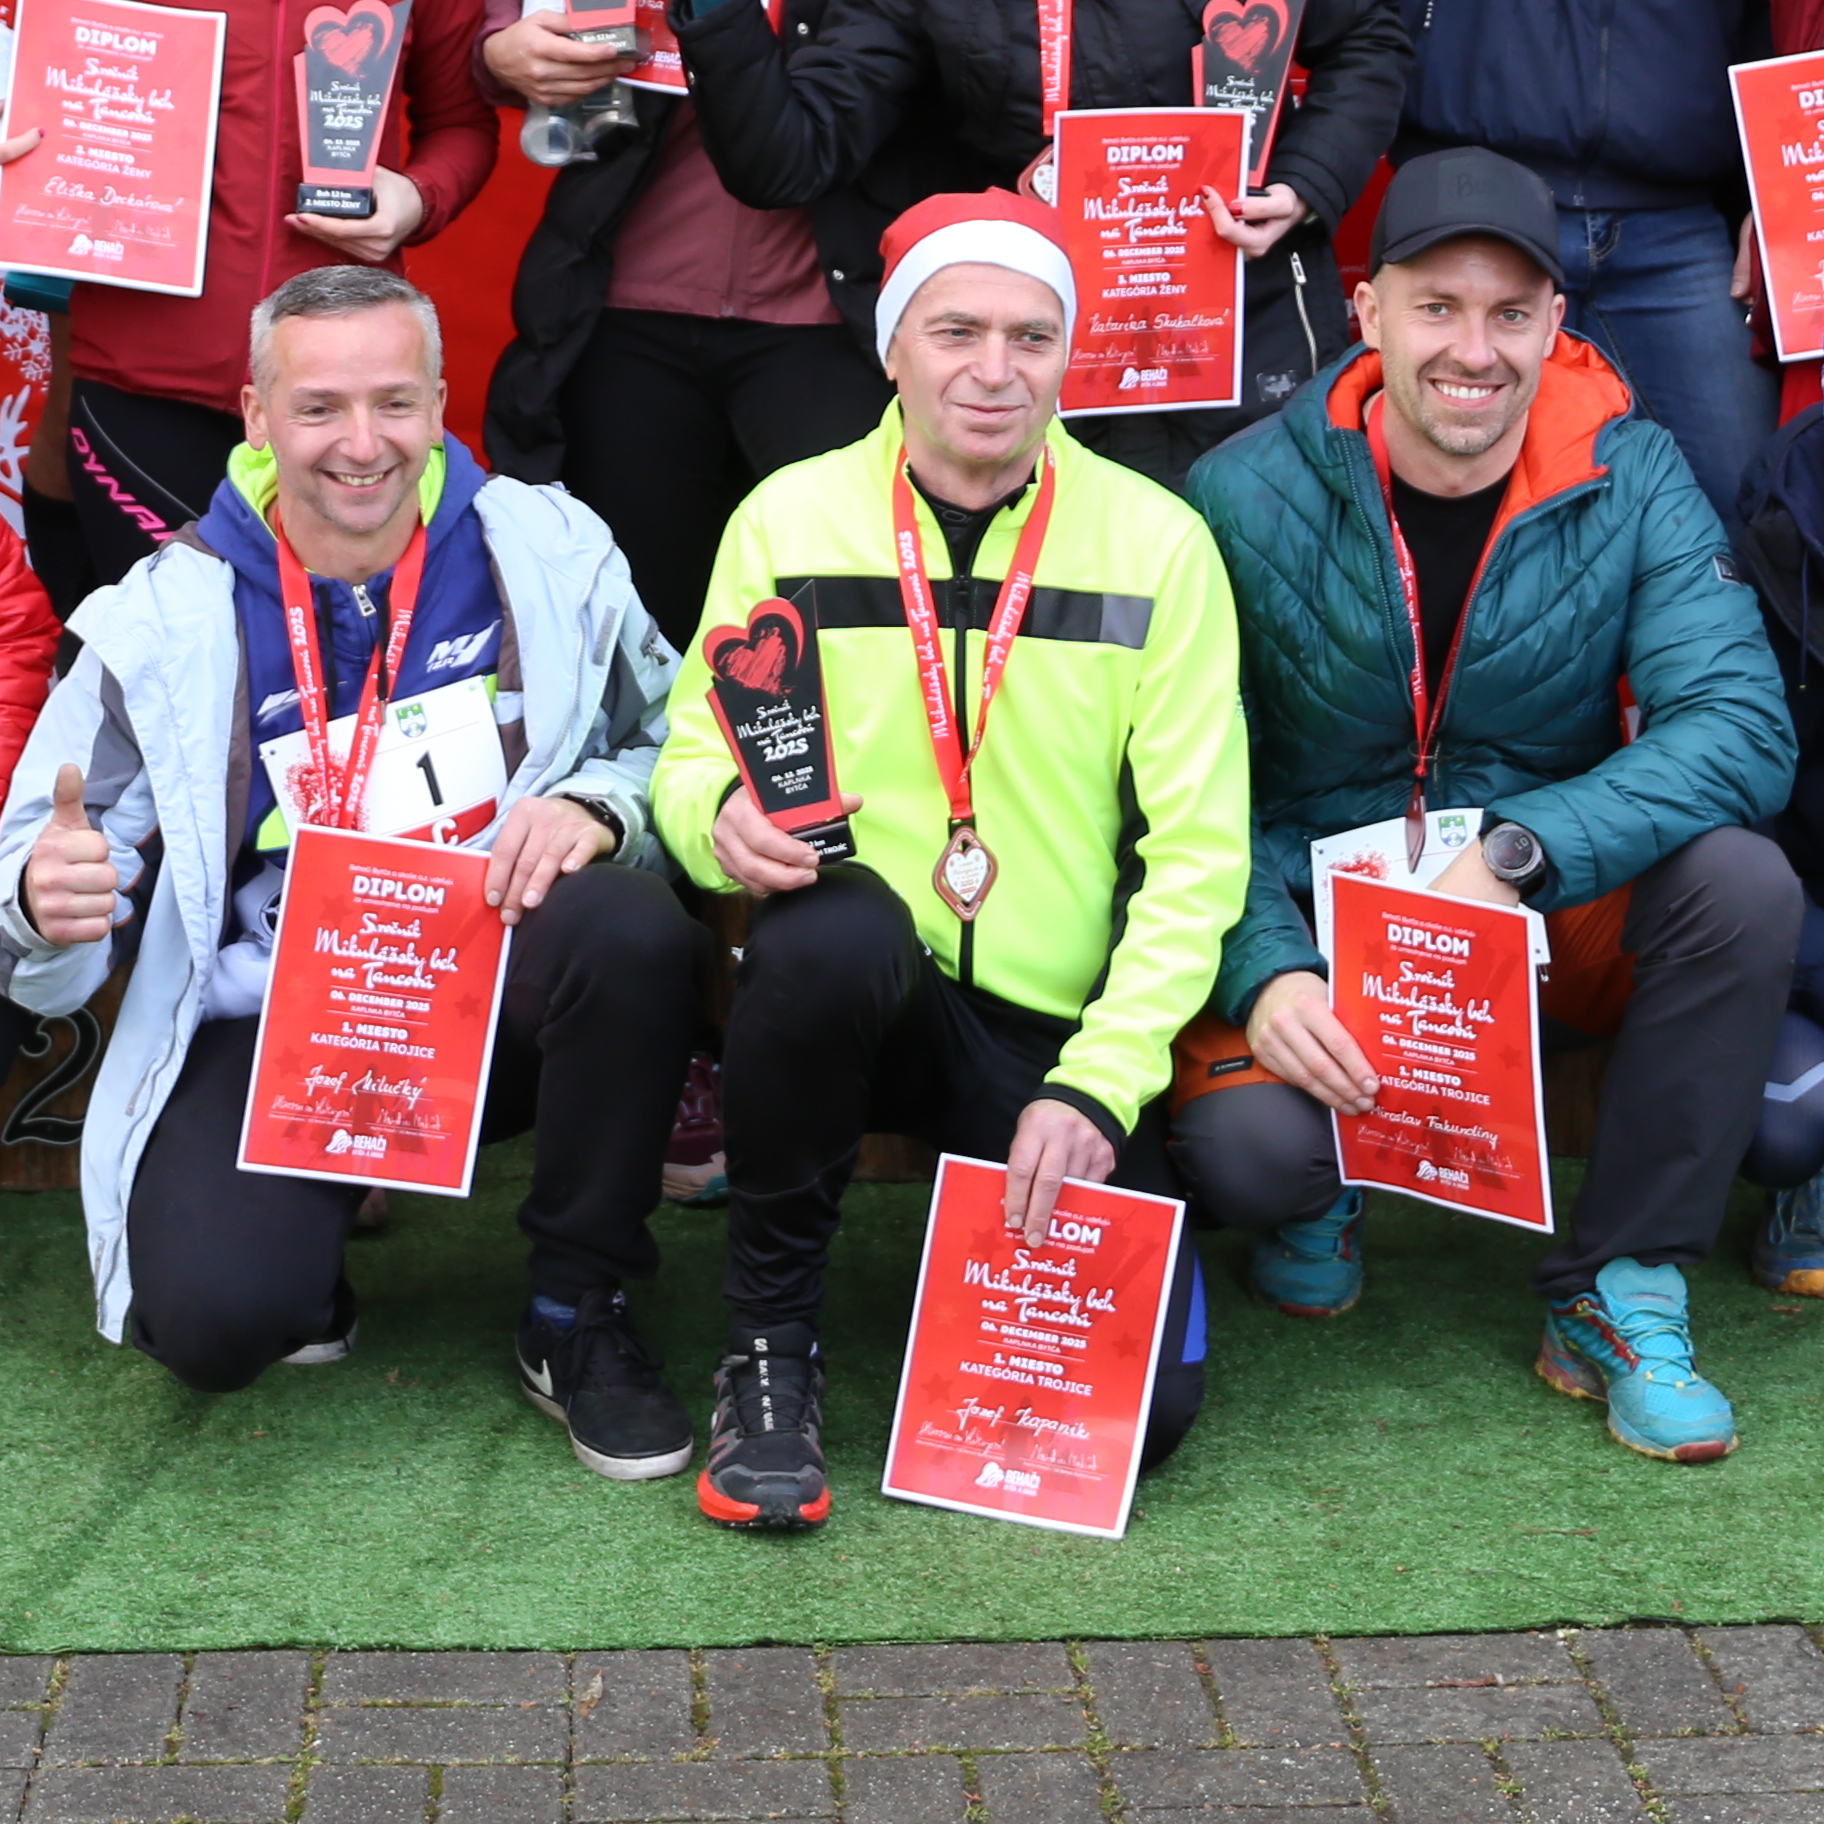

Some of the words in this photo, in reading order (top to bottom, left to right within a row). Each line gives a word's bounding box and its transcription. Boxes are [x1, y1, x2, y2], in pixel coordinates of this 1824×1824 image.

[75, 26, 157, 55] DIPLOM
[324, 114, 364, 131] 2025
[56, 153, 120, 173] KATEGÓRIA
[75, 145, 86, 155] 2.
[87, 147, 135, 164] MIESTO
[1106, 144, 1183, 163] DIPLOM
[1117, 274, 1127, 285] 3.
[1128, 271, 1171, 284] MIESTO
[1101, 285, 1158, 298] KATEGÓRIA
[899, 531, 916, 569] 2025
[290, 606, 308, 646] 2025
[763, 738, 809, 762] 2025
[416, 750, 444, 807] 1
[352, 874, 444, 905] DIPLOM
[1387, 923, 1469, 957] DIPLOM
[329, 989, 346, 1000] 06.
[347, 991, 404, 1008] DECEMBER
[404, 999, 430, 1012] 2025
[341, 1020, 353, 1033] 1.
[355, 1023, 408, 1040] MIESTO
[309, 1032, 380, 1051] KATEGÓRIA
[383, 1041, 435, 1059] TROJICE
[1381, 1034, 1397, 1045] 06.
[1398, 1037, 1451, 1056] DECEMBER
[1452, 1048, 1476, 1061] 2025
[1, 1006, 101, 1146] 2
[1398, 1064, 1410, 1077] 1.
[1412, 1067, 1461, 1086] MIESTO
[1440, 1086, 1490, 1106] TROJICE
[980, 1320, 998, 1332] 06.
[999, 1324, 1059, 1343] DECEMBER
[1060, 1335, 1087, 1349] 2025
[993, 1352, 1006, 1365] 1.
[1008, 1355, 1064, 1375] MIESTO
[959, 1360, 1034, 1385] KATEGÓRIA
[1037, 1375, 1093, 1396] TROJICE
